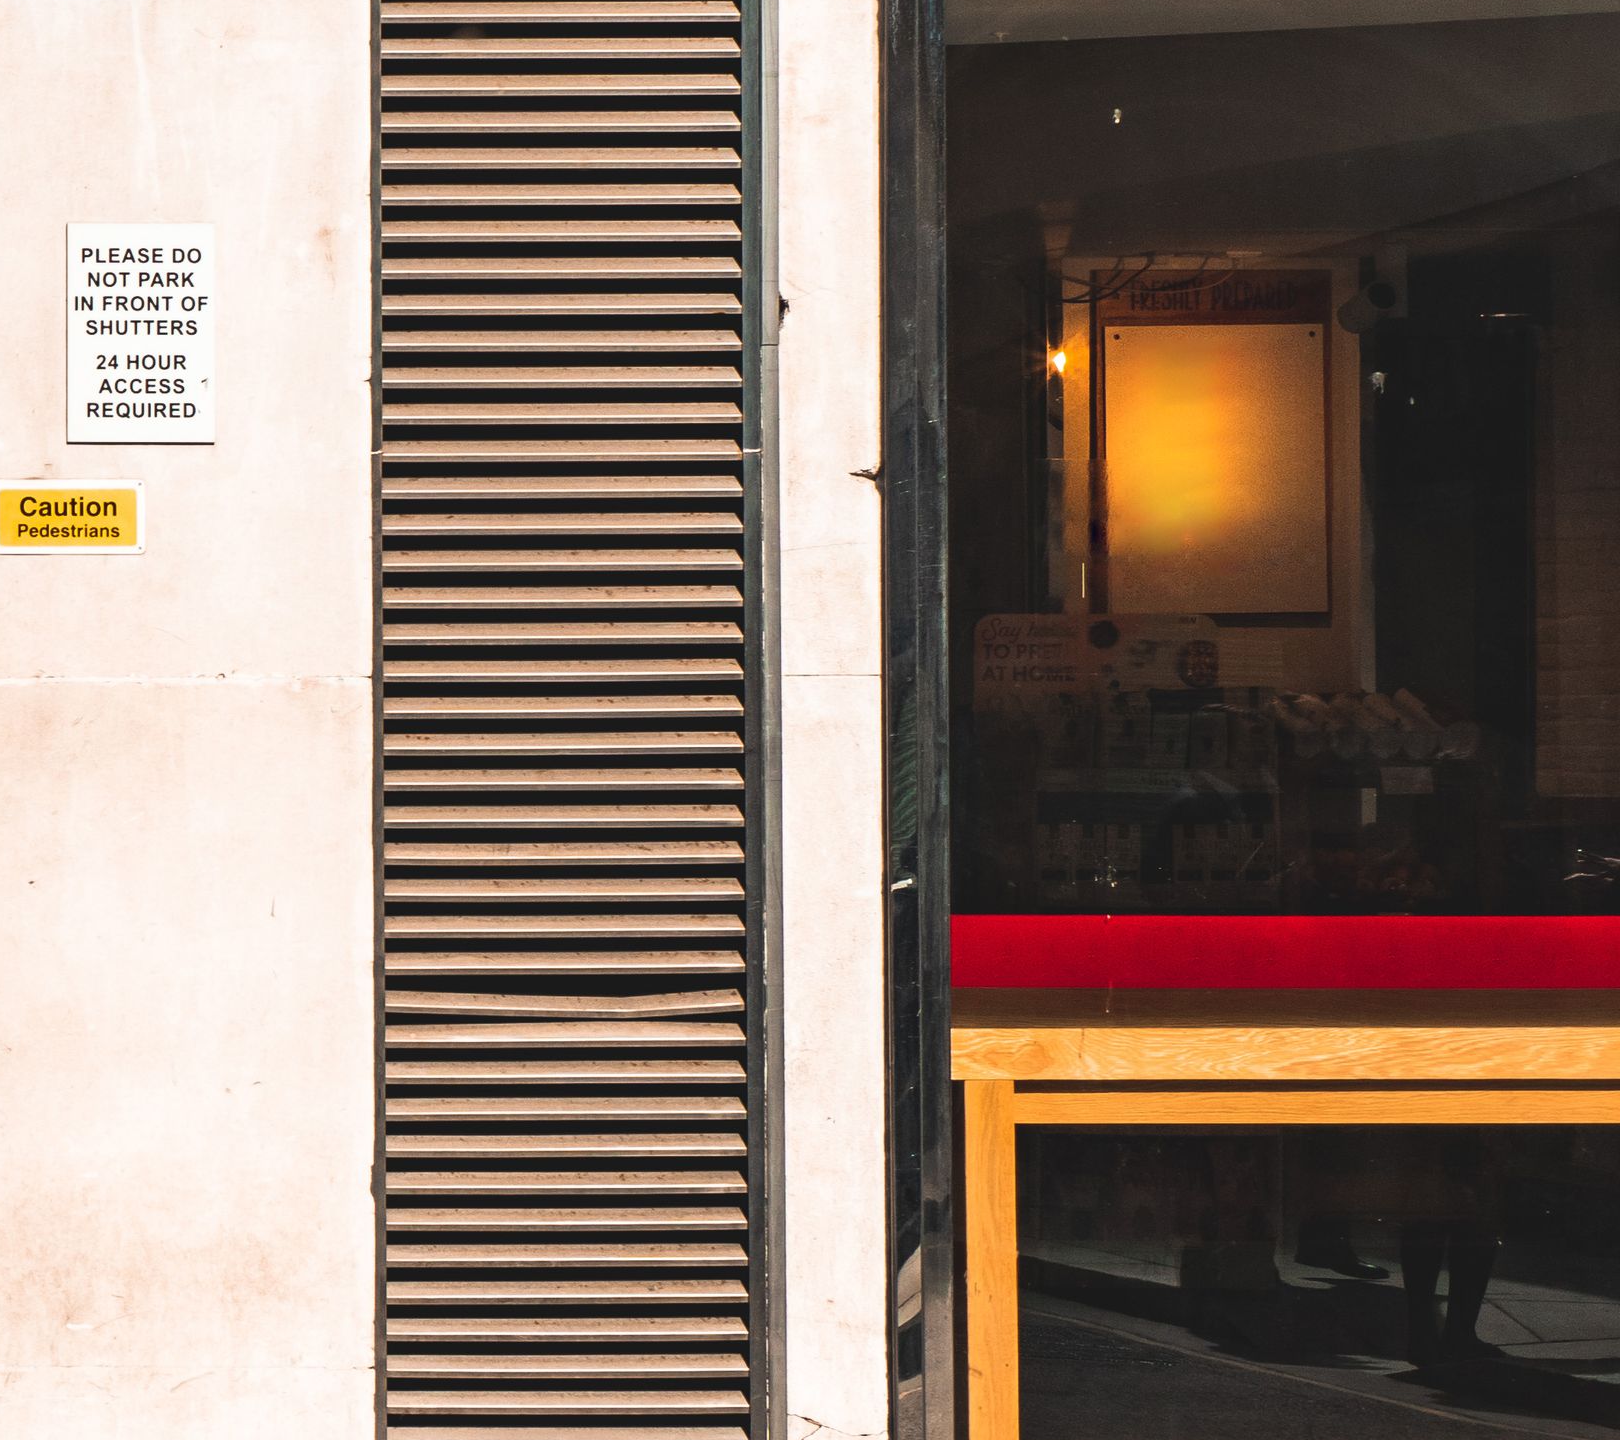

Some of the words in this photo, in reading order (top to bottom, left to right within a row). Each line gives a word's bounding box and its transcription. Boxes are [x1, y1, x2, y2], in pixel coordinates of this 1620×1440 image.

[82, 248, 163, 263] PLEASE
[173, 248, 201, 263] DO
[88, 272, 130, 287] NOT
[139, 272, 194, 287] PARK
[75, 296, 93, 311] IN
[103, 296, 173, 311] FRONT
[182, 296, 208, 311] OF
[86, 320, 197, 335] SHUTTERS
[97, 355, 118, 369] 24
[127, 355, 186, 370] HOUR
[99, 379, 184, 394] ACCESS
[88, 403, 196, 418] REQUIRED
[20, 497, 116, 516] Caution
[18, 524, 119, 537] Pedestrians
